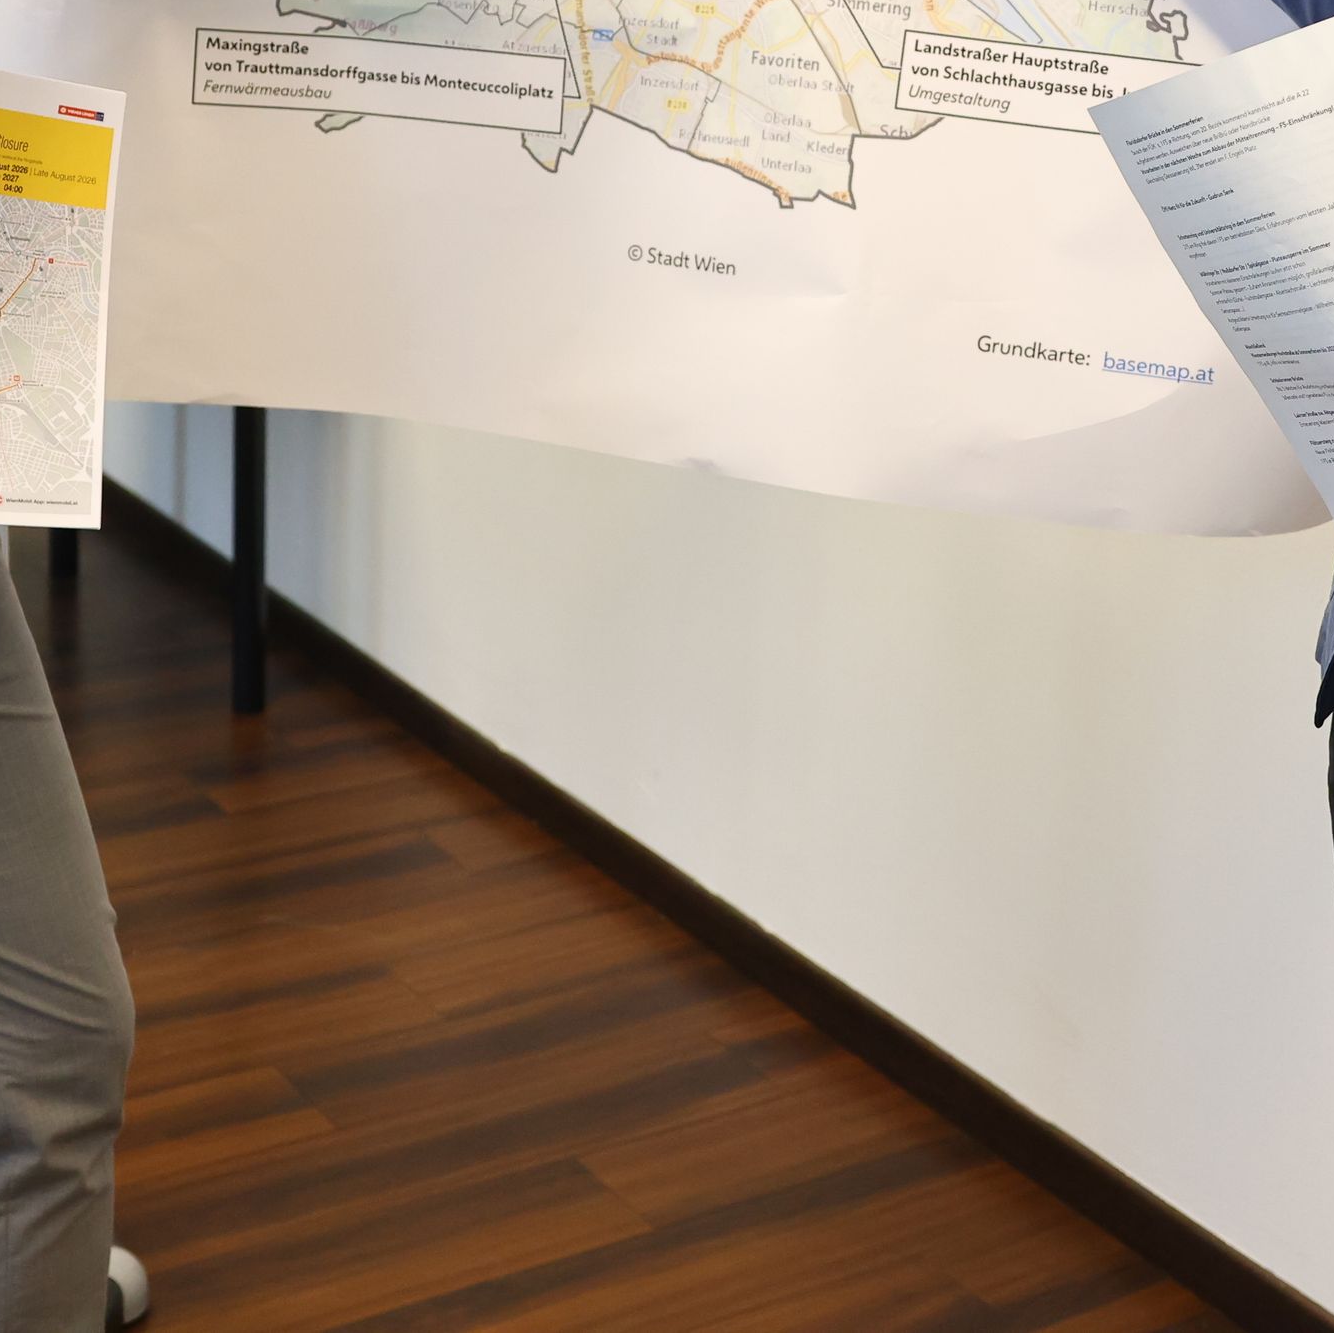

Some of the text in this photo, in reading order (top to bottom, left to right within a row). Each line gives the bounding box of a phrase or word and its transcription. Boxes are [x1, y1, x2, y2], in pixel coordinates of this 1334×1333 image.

[206, 37, 309, 55] Maxingstraße
[751, 50, 820, 71] Favoriten
[914, 40, 1109, 75] Landstraßer Hauptstraße
[203, 79, 332, 99] Fernwärmeausbau
[205, 60, 553, 100] von Trauttmansdorffgasse bis Montecuccoliplatz
[641, 76, 699, 91] Inzersdorf
[911, 65, 1113, 98] von Schlachthausgasse bis
[908, 84, 1011, 113] Umgestaltung
[807, 141, 848, 155] Kleder
[11, 164, 28, 175] 2026
[33, 168, 49, 179] Late
[51, 172, 75, 183] August
[76, 175, 96, 185] 2026
[762, 158, 812, 173] Unterlaa
[2, 173, 19, 183] 2027
[4, 183, 23, 194] 04:00
[647, 247, 736, 275] Stadt Wien
[977, 335, 1214, 383] Grundkarte: basemap.at
